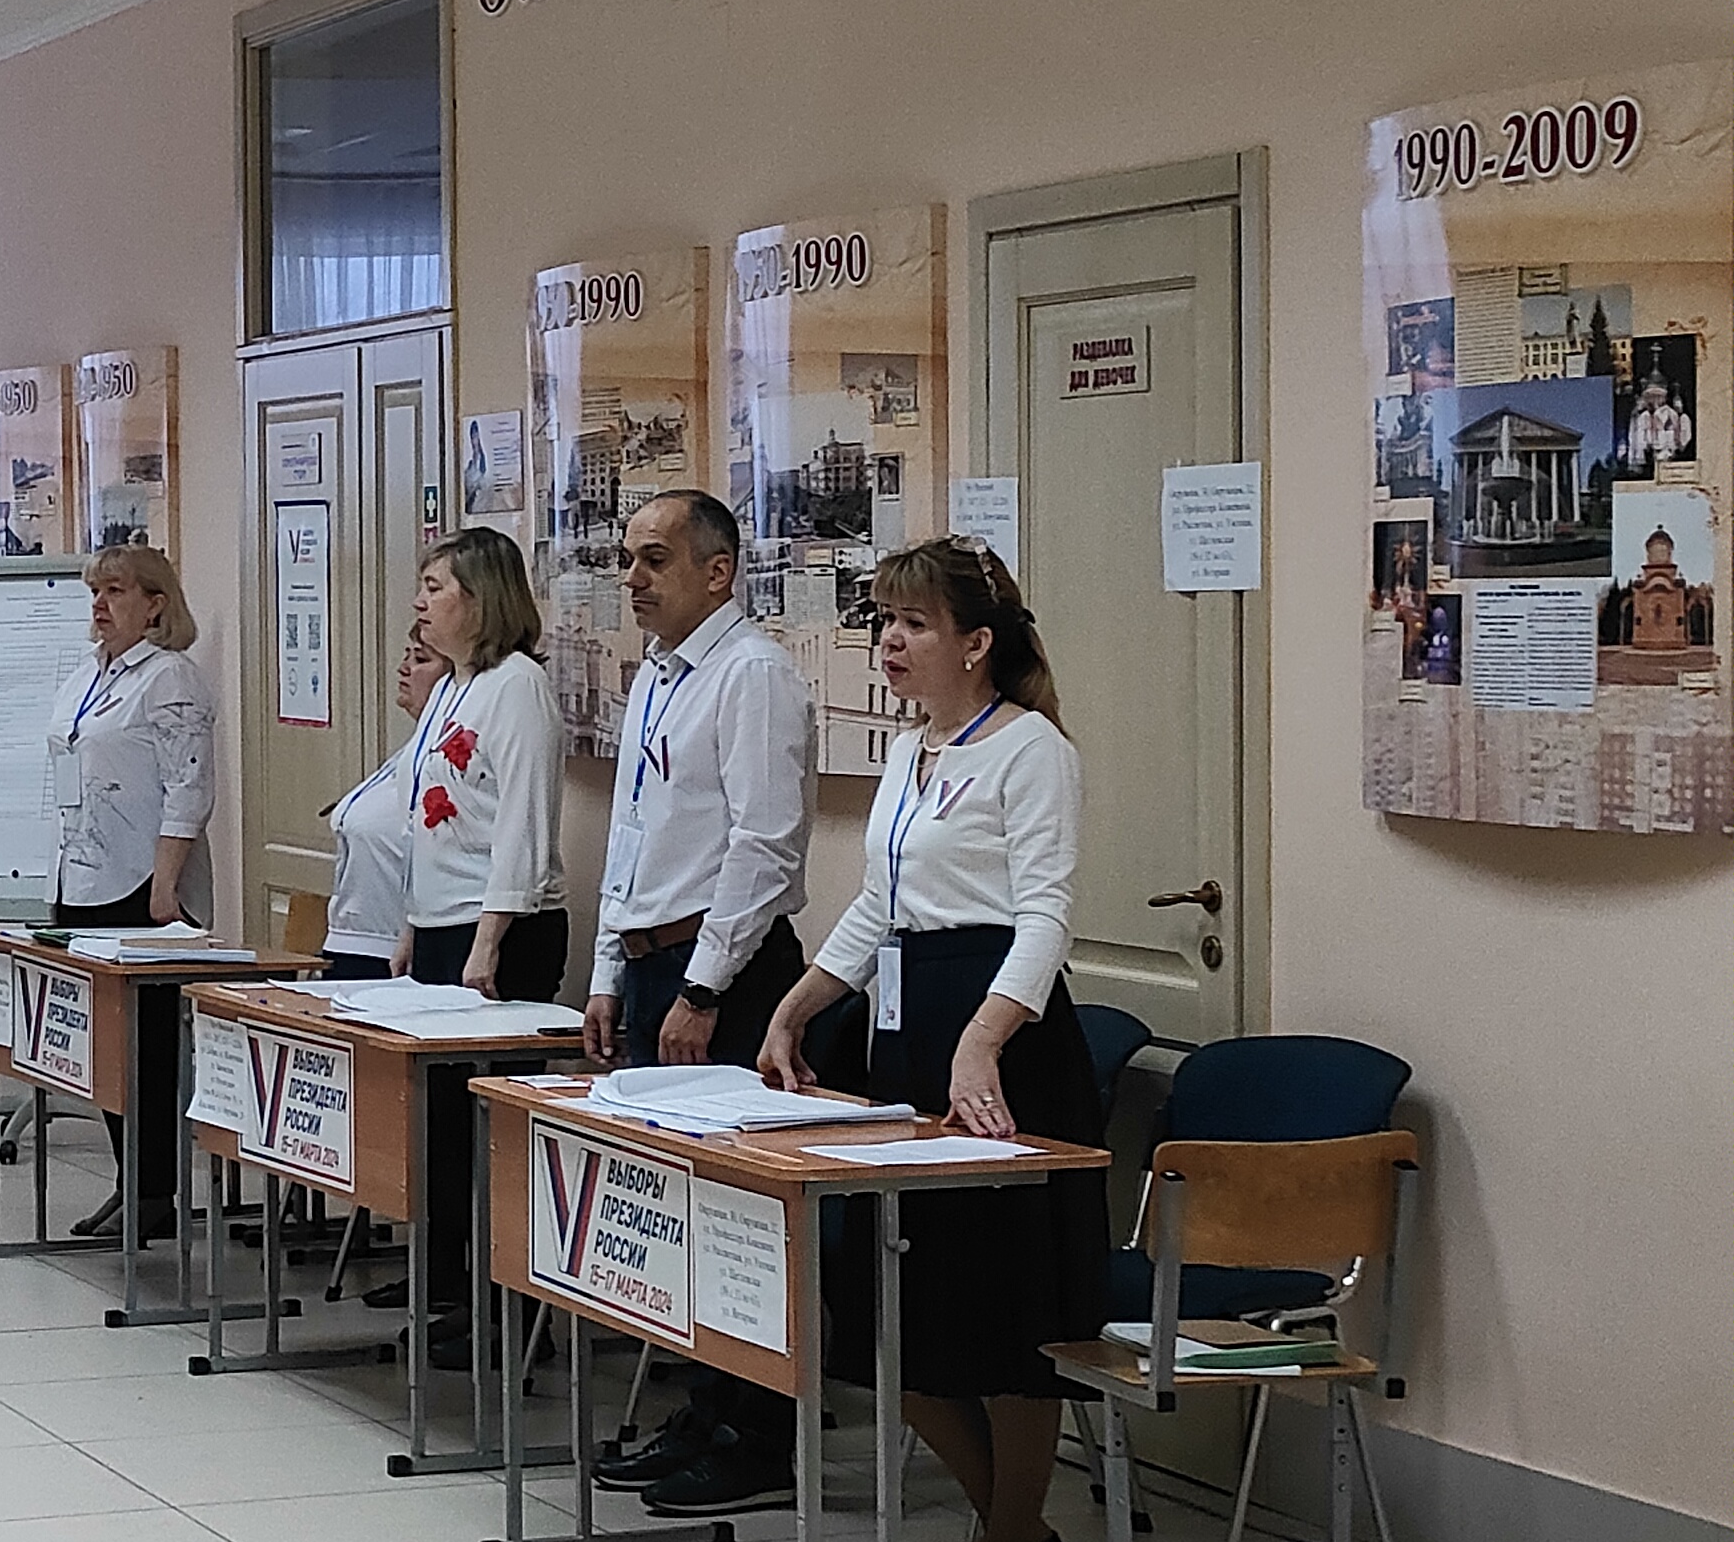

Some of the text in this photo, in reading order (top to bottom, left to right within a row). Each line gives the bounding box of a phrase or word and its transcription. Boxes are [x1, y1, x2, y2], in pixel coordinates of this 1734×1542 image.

[1394, 100, 1638, 199] 1990-2009
[1072, 337, 1134, 363] РАЗДЕВАЛКА
[1069, 364, 1137, 393] ДЛЯ ДЕВОЧЕК
[46, 1001, 89, 1033] ПРЕЗИДЕНТА
[44, 1025, 71, 1052] РОССИИ
[292, 1047, 336, 1078] ВЫБОРЫ
[287, 1077, 348, 1113] ПРЕЗИДЕНТА
[283, 1105, 323, 1137] РОССИИ
[299, 1140, 323, 1165] МАРТА
[606, 1157, 667, 1202] ВЫБОРЫ
[599, 1193, 685, 1248] ПРЕЗИДЕНТА
[594, 1228, 649, 1272] РОССИИ
[614, 1273, 648, 1308] МАРТА
[647, 1284, 674, 1316] 2024
